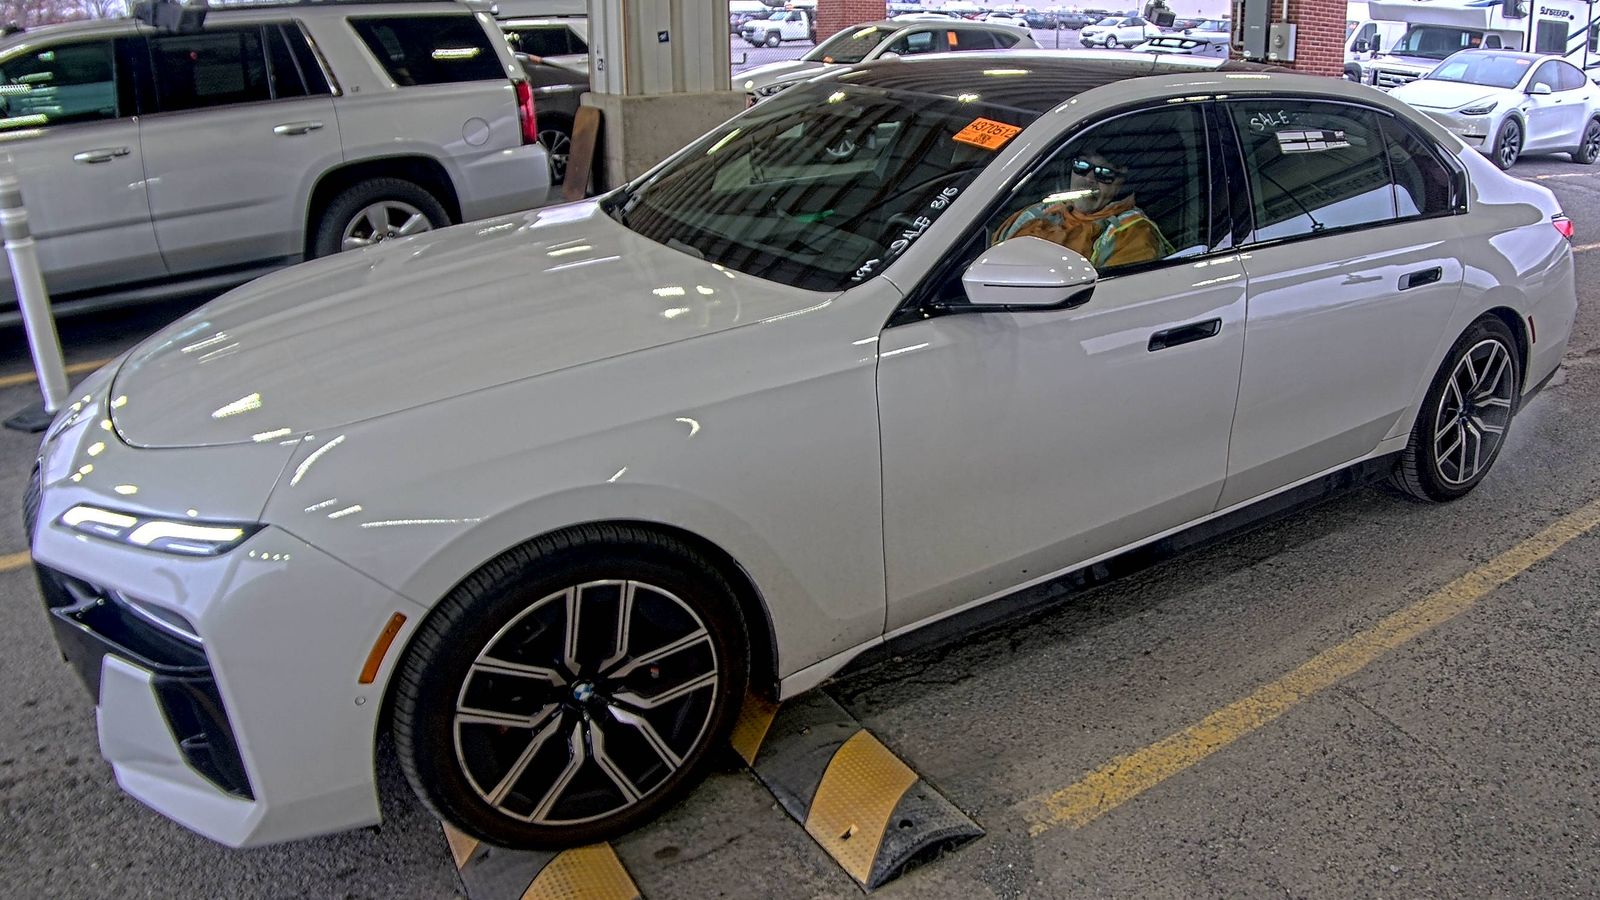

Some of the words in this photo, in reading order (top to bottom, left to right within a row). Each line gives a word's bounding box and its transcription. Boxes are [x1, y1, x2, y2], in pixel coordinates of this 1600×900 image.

[971, 121, 1018, 138] 4370512
[1250, 110, 1289, 131] SALE
[890, 215, 931, 255] SALE
